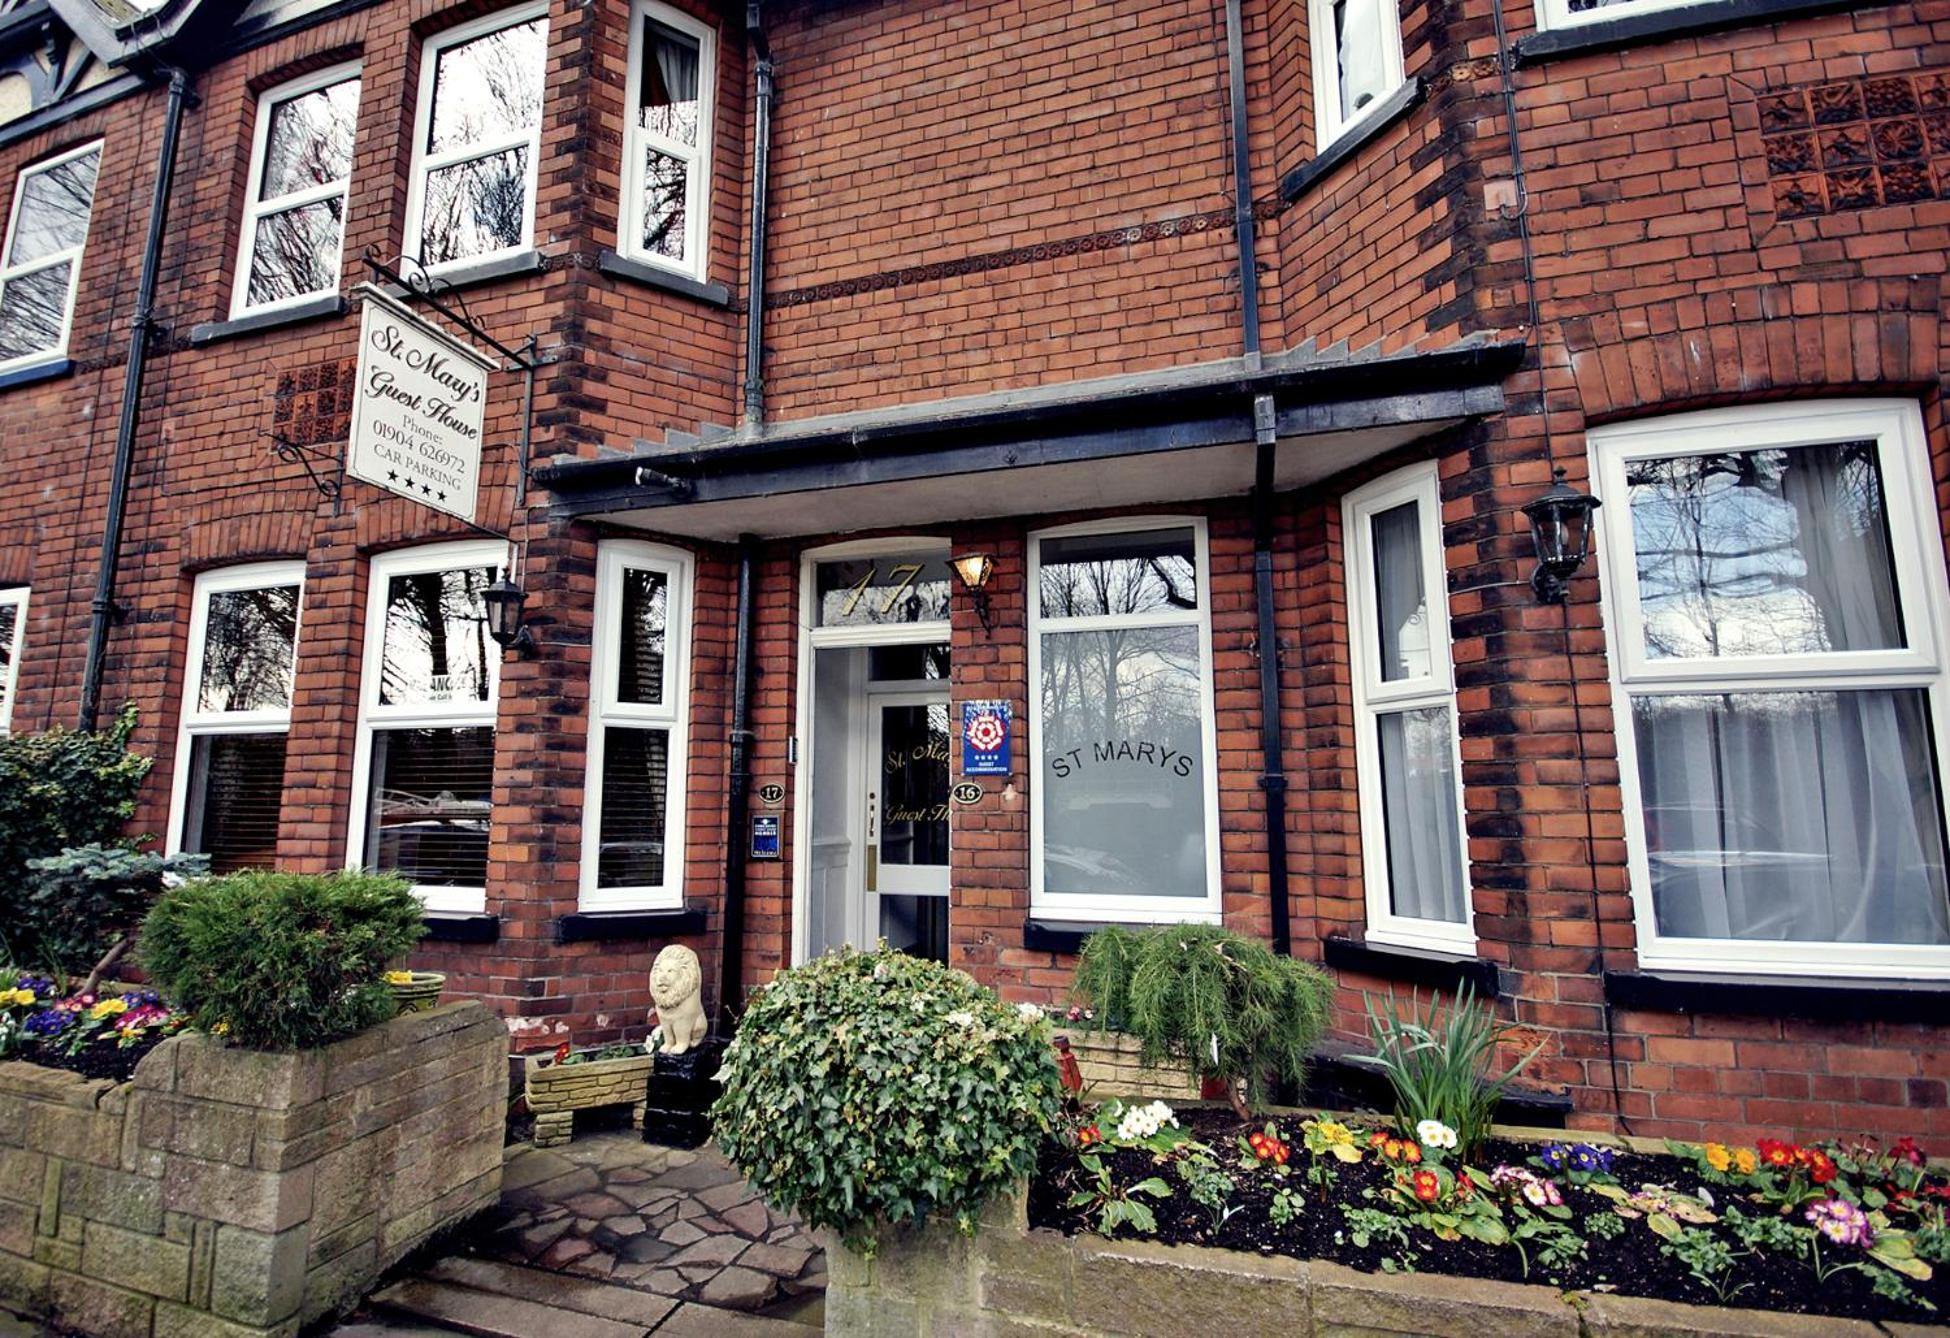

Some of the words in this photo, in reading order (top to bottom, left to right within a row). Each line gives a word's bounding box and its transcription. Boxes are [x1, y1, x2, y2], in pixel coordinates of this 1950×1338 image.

[405, 349, 480, 403] Mary's
[364, 365, 422, 411] Guest
[421, 397, 478, 440] House
[373, 419, 414, 450] 01904
[419, 441, 465, 474] 626972
[403, 414, 444, 446] Phone:
[374, 443, 402, 465] CAR
[405, 455, 462, 491] PARKING
[841, 561, 926, 617] 17
[1051, 747, 1083, 778] ST
[1092, 740, 1194, 777] MARYS
[766, 787, 779, 799] 17
[885, 803, 927, 826] Guest
[959, 786, 976, 800] 16
